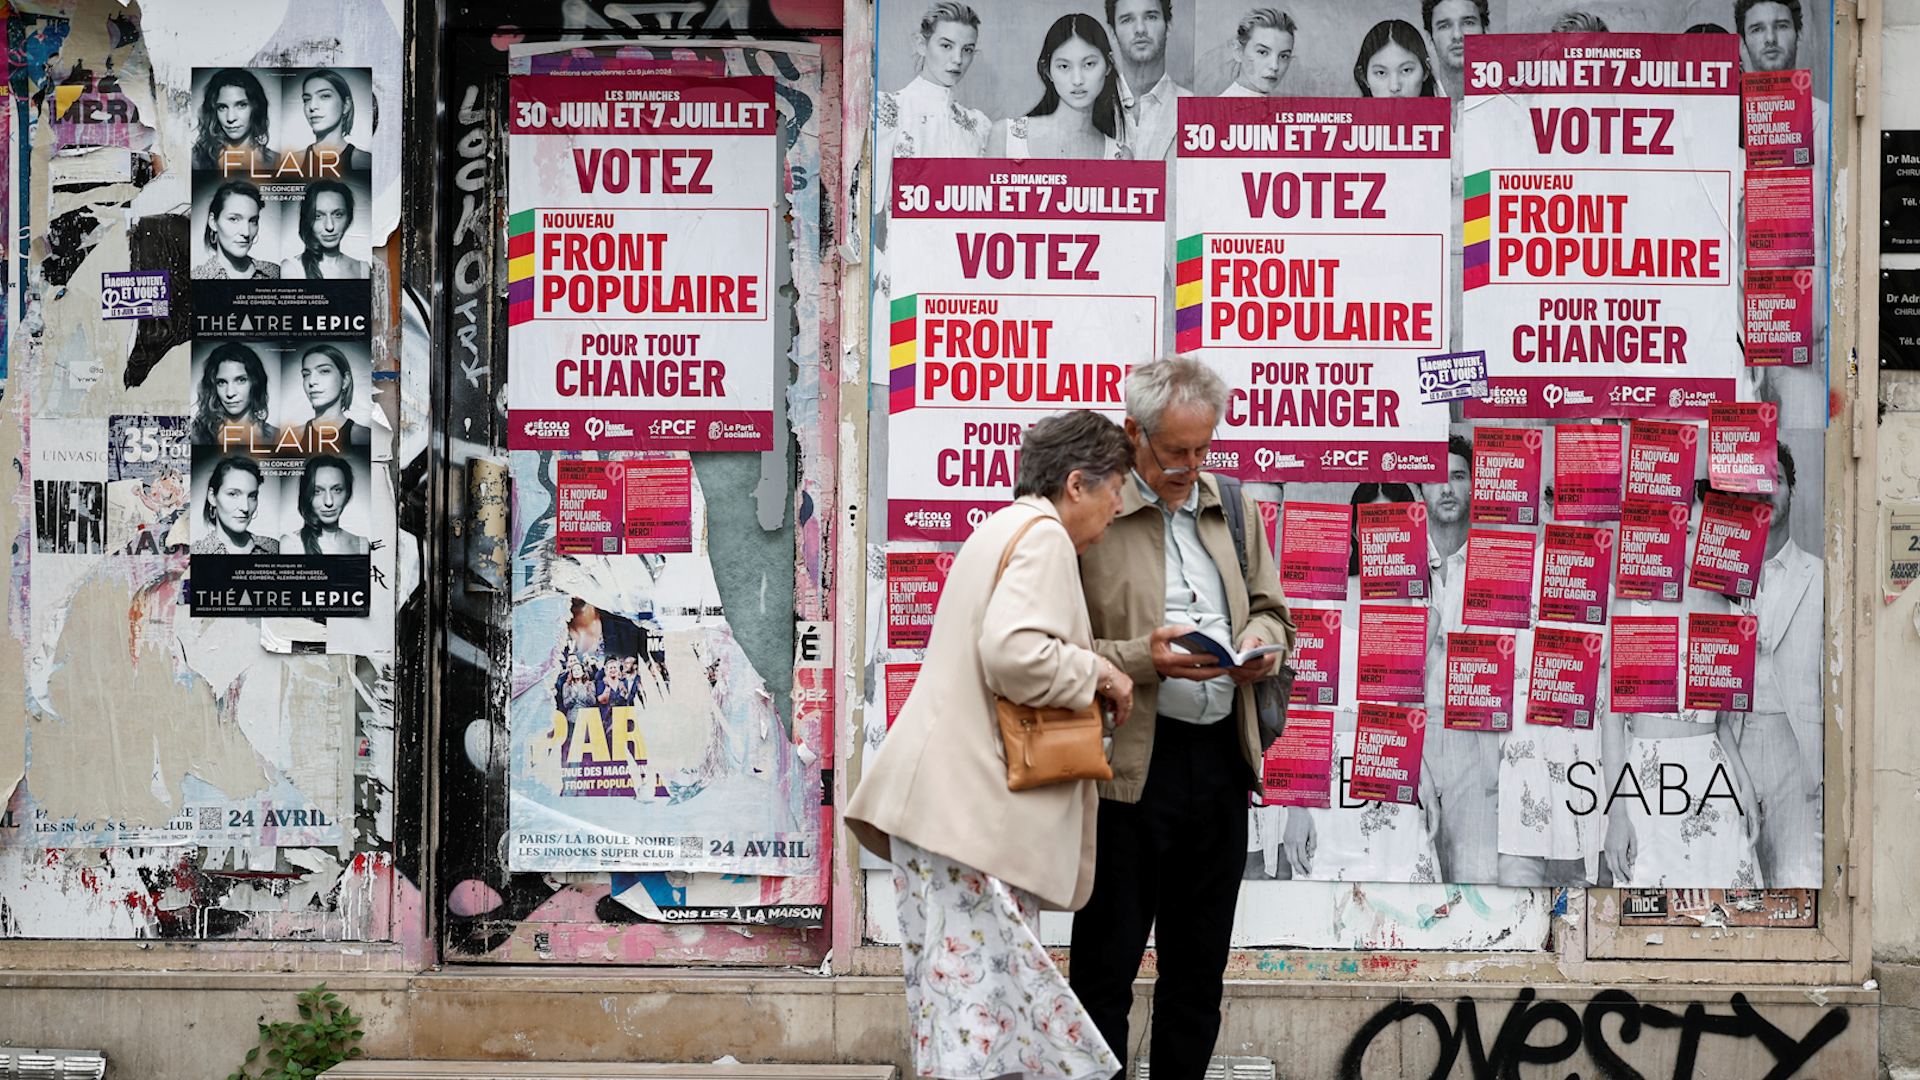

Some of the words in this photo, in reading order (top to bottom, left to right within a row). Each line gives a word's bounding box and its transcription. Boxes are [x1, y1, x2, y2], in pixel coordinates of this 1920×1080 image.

[1564, 48, 1583, 58] LES
[1586, 48, 1641, 59] DIMANCHES
[1471, 61, 1502, 88] 30
[1508, 60, 1567, 87] JUIN
[1574, 60, 1605, 86] ET
[1611, 60, 1626, 86] 7
[1631, 60, 1732, 88] JUILLET
[605, 91, 623, 101] LES
[626, 91, 680, 101] DIMANCHES
[1746, 102, 1756, 111] LE
[1758, 101, 1794, 111] NOUVEAU
[516, 102, 546, 128] 30
[552, 102, 608, 128] JUIN
[614, 103, 644, 128] ET
[650, 103, 666, 128] 7
[670, 103, 769, 128] JUILLET
[1276, 112, 1294, 123] LES
[1296, 112, 1352, 123] DIMANCHES
[1748, 112, 1772, 122] FRONT
[1530, 107, 1674, 154] VOTEZ
[1748, 122, 1790, 133] POPULAIRE
[1184, 124, 1215, 150] 30
[1221, 124, 1278, 150] JUIN
[1284, 124, 1316, 150] ET
[1322, 124, 1338, 151] 7
[1342, 124, 1444, 152] JUILLET
[1749, 134, 1768, 146] PEUT
[1769, 133, 1802, 144] GAGNER
[224, 151, 340, 178] FLAIR
[1887, 155, 1899, 163] Dr
[572, 148, 713, 194] VOTEZ
[990, 174, 1008, 184] LES
[1011, 174, 1067, 185] DIMANCHES
[1499, 175, 1573, 189] NOUVEAU
[899, 185, 930, 211] 30
[935, 186, 992, 211] JUIN
[999, 186, 1031, 212] ET
[1036, 186, 1052, 212] 7
[1056, 187, 1159, 214] JUILLET
[1242, 172, 1386, 218] VOTEZ
[543, 214, 614, 228] NOUVEAU
[1499, 195, 1628, 234] FRONT
[543, 233, 667, 271] FRONT
[1212, 239, 1284, 254] NOUVEAU
[956, 233, 1100, 280] VOTEZ
[1499, 237, 1720, 278] POPULAIRE
[104, 277, 135, 287] MACHOS
[1211, 258, 1340, 297] FRONT
[122, 287, 132, 299] ET
[133, 286, 159, 299] VOUS
[160, 286, 166, 298] ?
[543, 274, 758, 313] POPULAIRE
[1886, 294, 1899, 303] Dr
[926, 299, 998, 314] NOUVEAU
[1540, 299, 1597, 321] POUR
[1604, 299, 1660, 321] TOUT
[302, 316, 365, 330] LEPIC
[1211, 302, 1432, 341] POPULAIRE
[582, 334, 638, 356] POUR
[645, 334, 700, 356] TOUT
[925, 319, 1053, 359] FRONT
[1513, 325, 1687, 364] CHANGER
[1421, 359, 1452, 372] MACHOS
[556, 360, 726, 397] CHANGER
[1252, 362, 1308, 384] POUR
[1316, 363, 1373, 385] TOUT
[1438, 370, 1449, 382] ET
[1450, 366, 1477, 381] VOUS
[1478, 366, 1484, 378] ?
[1494, 386, 1527, 397] ÉCOLO
[1622, 387, 1656, 402] PCF
[1224, 389, 1400, 427] CHANGER
[1494, 397, 1527, 405] GISTES
[538, 419, 570, 429] ÉCOLO
[661, 420, 696, 435] PCF
[724, 423, 734, 431] Le
[736, 423, 754, 431] Parti
[224, 426, 340, 453] FLAIR
[538, 429, 570, 437] GISTES
[724, 431, 761, 439] socialiste
[964, 423, 1021, 445] POUR
[125, 427, 158, 462] 35
[1333, 450, 1368, 466] PCF
[1398, 454, 1407, 462] Le
[1409, 454, 1428, 462] Parti
[1398, 462, 1435, 471] socialiste
[560, 489, 569, 499] LE
[570, 489, 607, 499] NOUVEAU
[560, 500, 585, 510] FRONT
[560, 510, 601, 521] POPULAIRE
[560, 521, 579, 532] PEUT
[580, 522, 612, 532] GAGNER
[1361, 533, 1371, 543] LE
[1372, 532, 1410, 543] NOUVEAU
[1362, 544, 1388, 554] FRONT
[1363, 555, 1405, 565] POPULAIRE
[1363, 566, 1383, 577] PEUT
[1384, 565, 1416, 576] GAGNER
[302, 591, 364, 606] LEPIC
[1614, 686, 1635, 694] MERCI
[565, 780, 595, 790] FRONT
[1566, 761, 1744, 816] SABA
[229, 810, 253, 827] 24
[264, 810, 332, 827] AVRIL
[36, 823, 57, 832] LES
[519, 834, 562, 845] PARIS/
[566, 834, 582, 844] LA
[587, 835, 630, 845] BOULE
[635, 836, 675, 846] NOIRE
[519, 847, 540, 856] LES
[544, 847, 597, 857] INROCKS
[601, 848, 639, 858] SUPER
[643, 848, 674, 858] CLUB
[709, 839, 734, 856] 24
[744, 841, 810, 858] AVRIL
[704, 909, 725, 918] LES
[730, 906, 742, 919] À
[746, 909, 765, 921] LA
[768, 908, 823, 920] MAISON
